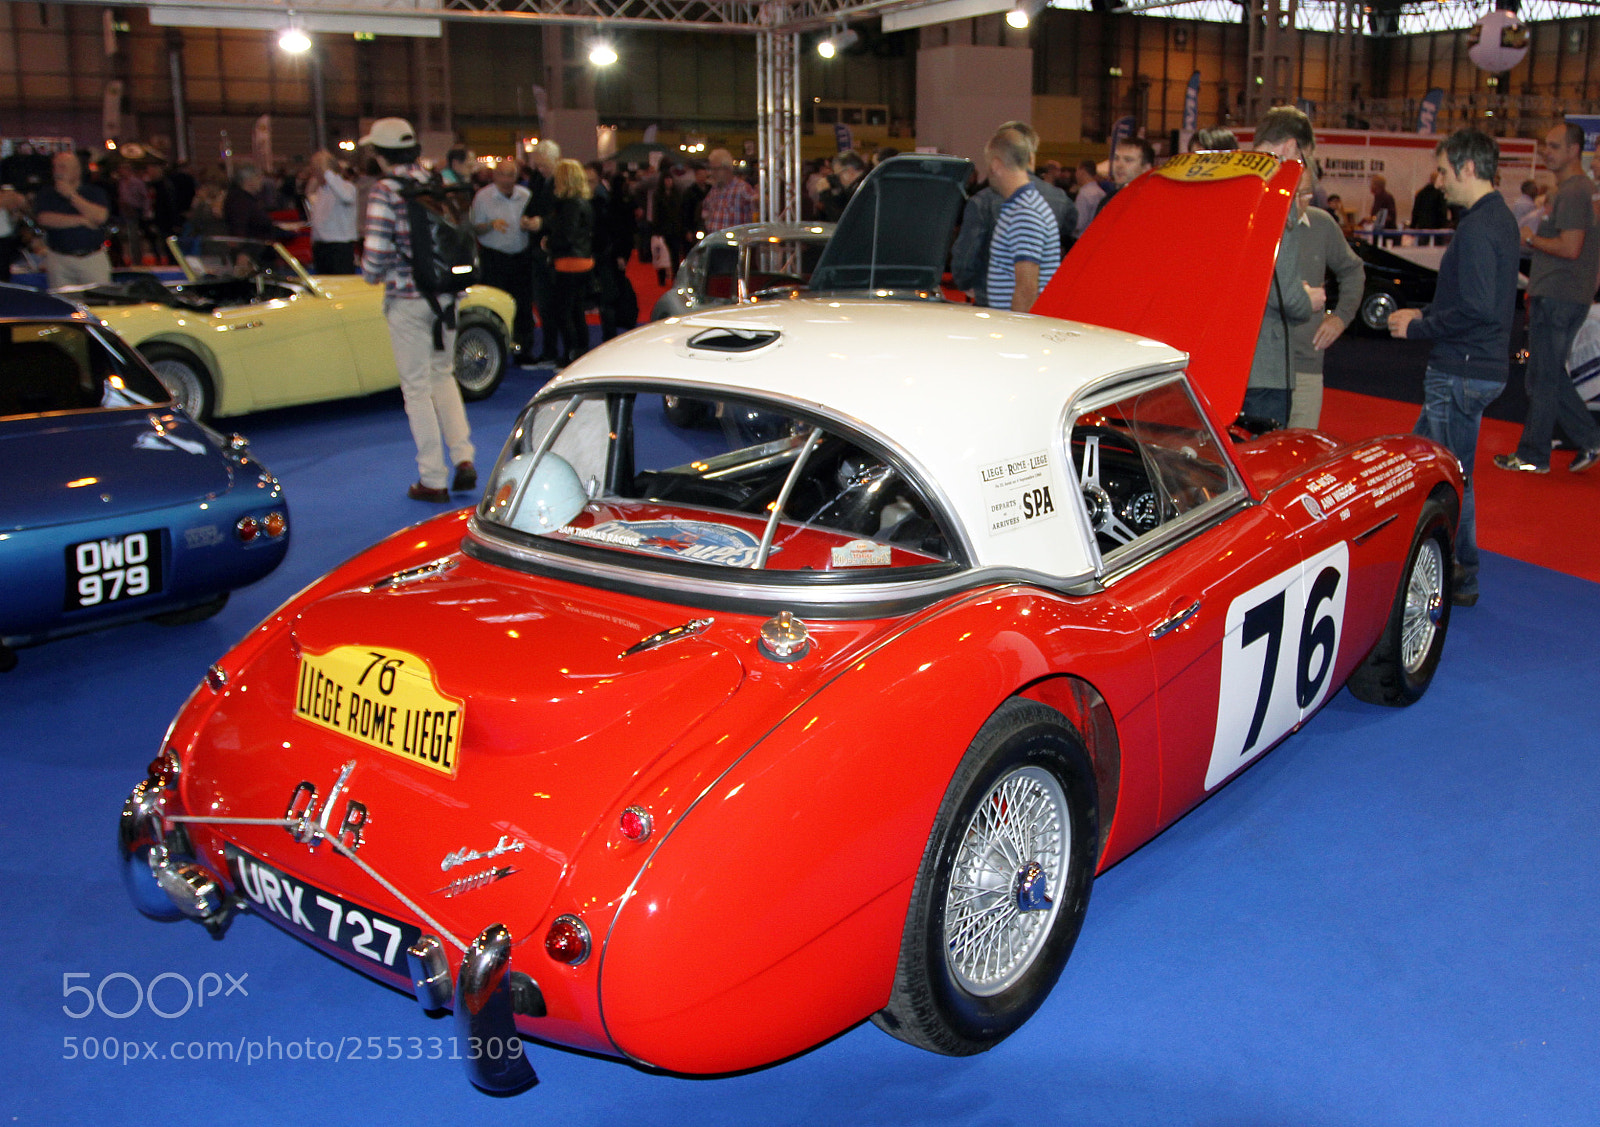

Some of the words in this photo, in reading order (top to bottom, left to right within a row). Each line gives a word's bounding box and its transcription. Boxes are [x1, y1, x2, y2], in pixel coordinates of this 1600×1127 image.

[1022, 485, 1054, 520] SPA
[76, 532, 149, 574] OWO
[558, 524, 575, 535] SAM
[575, 527, 607, 542] THOMAS
[606, 532, 640, 546] RACING
[77, 565, 150, 606] 979
[357, 652, 404, 695] 76
[1240, 566, 1341, 757] 76
[347, 691, 397, 747] ROME
[237, 855, 315, 932] URX
[316, 895, 402, 967] 727
